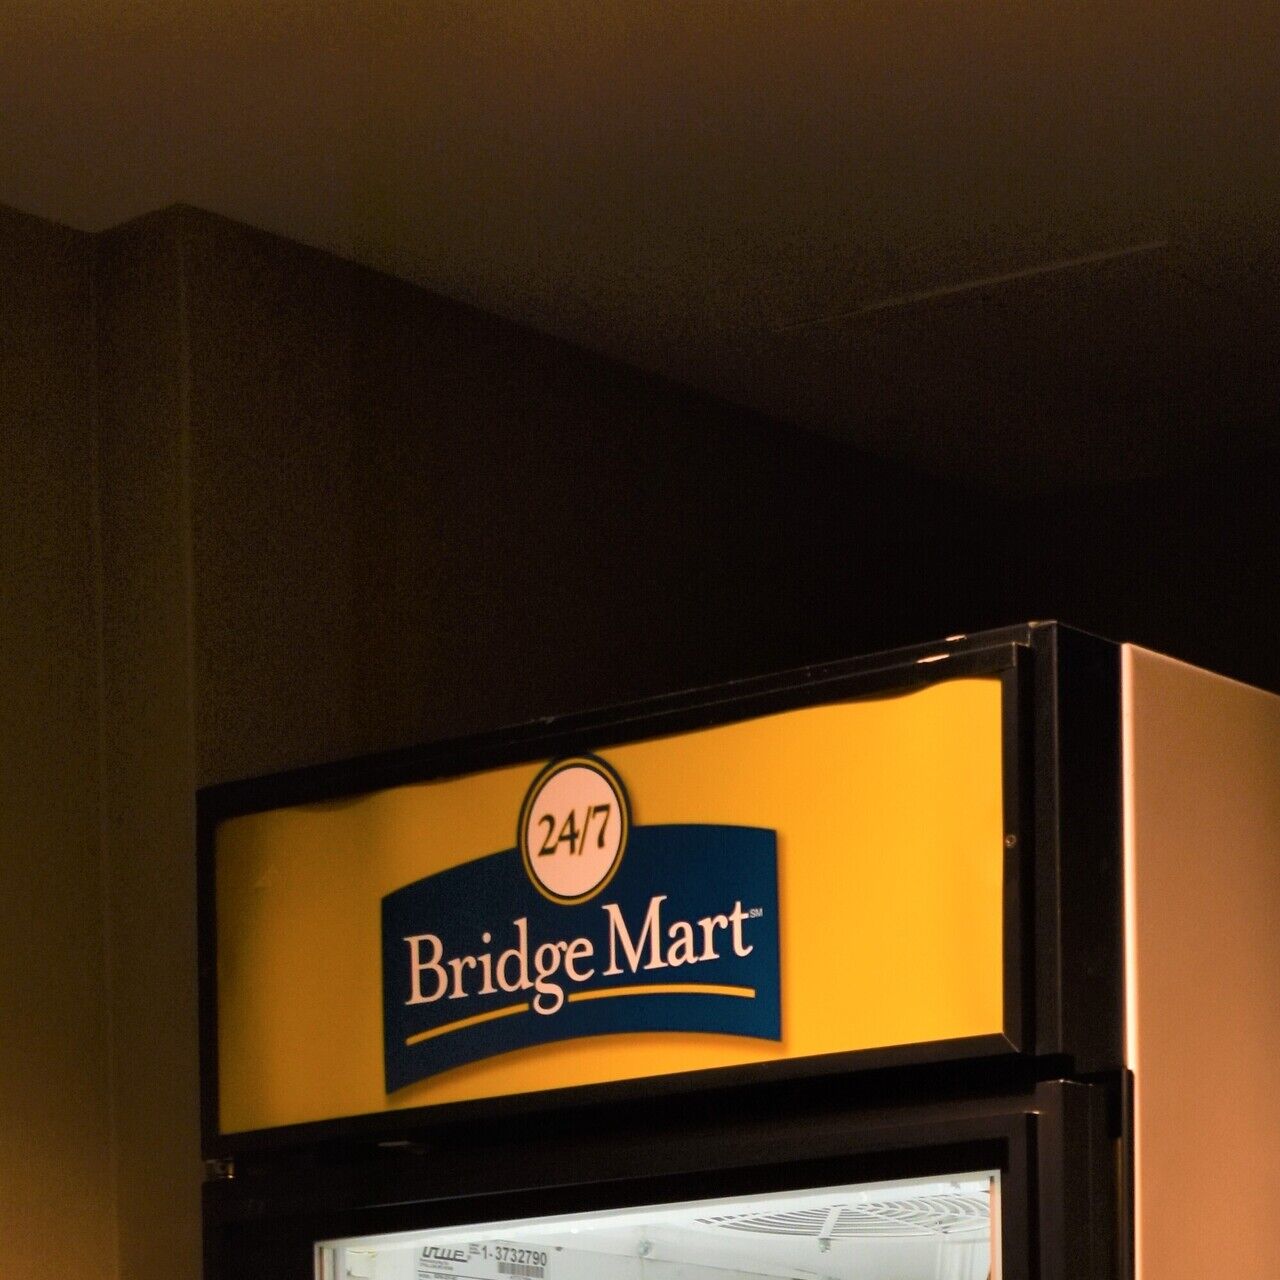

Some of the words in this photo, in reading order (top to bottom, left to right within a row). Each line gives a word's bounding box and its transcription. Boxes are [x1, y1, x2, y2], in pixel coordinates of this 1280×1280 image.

[538, 804, 611, 857] 24/7
[404, 917, 595, 1016] Bridge
[602, 896, 753, 977] Mart
